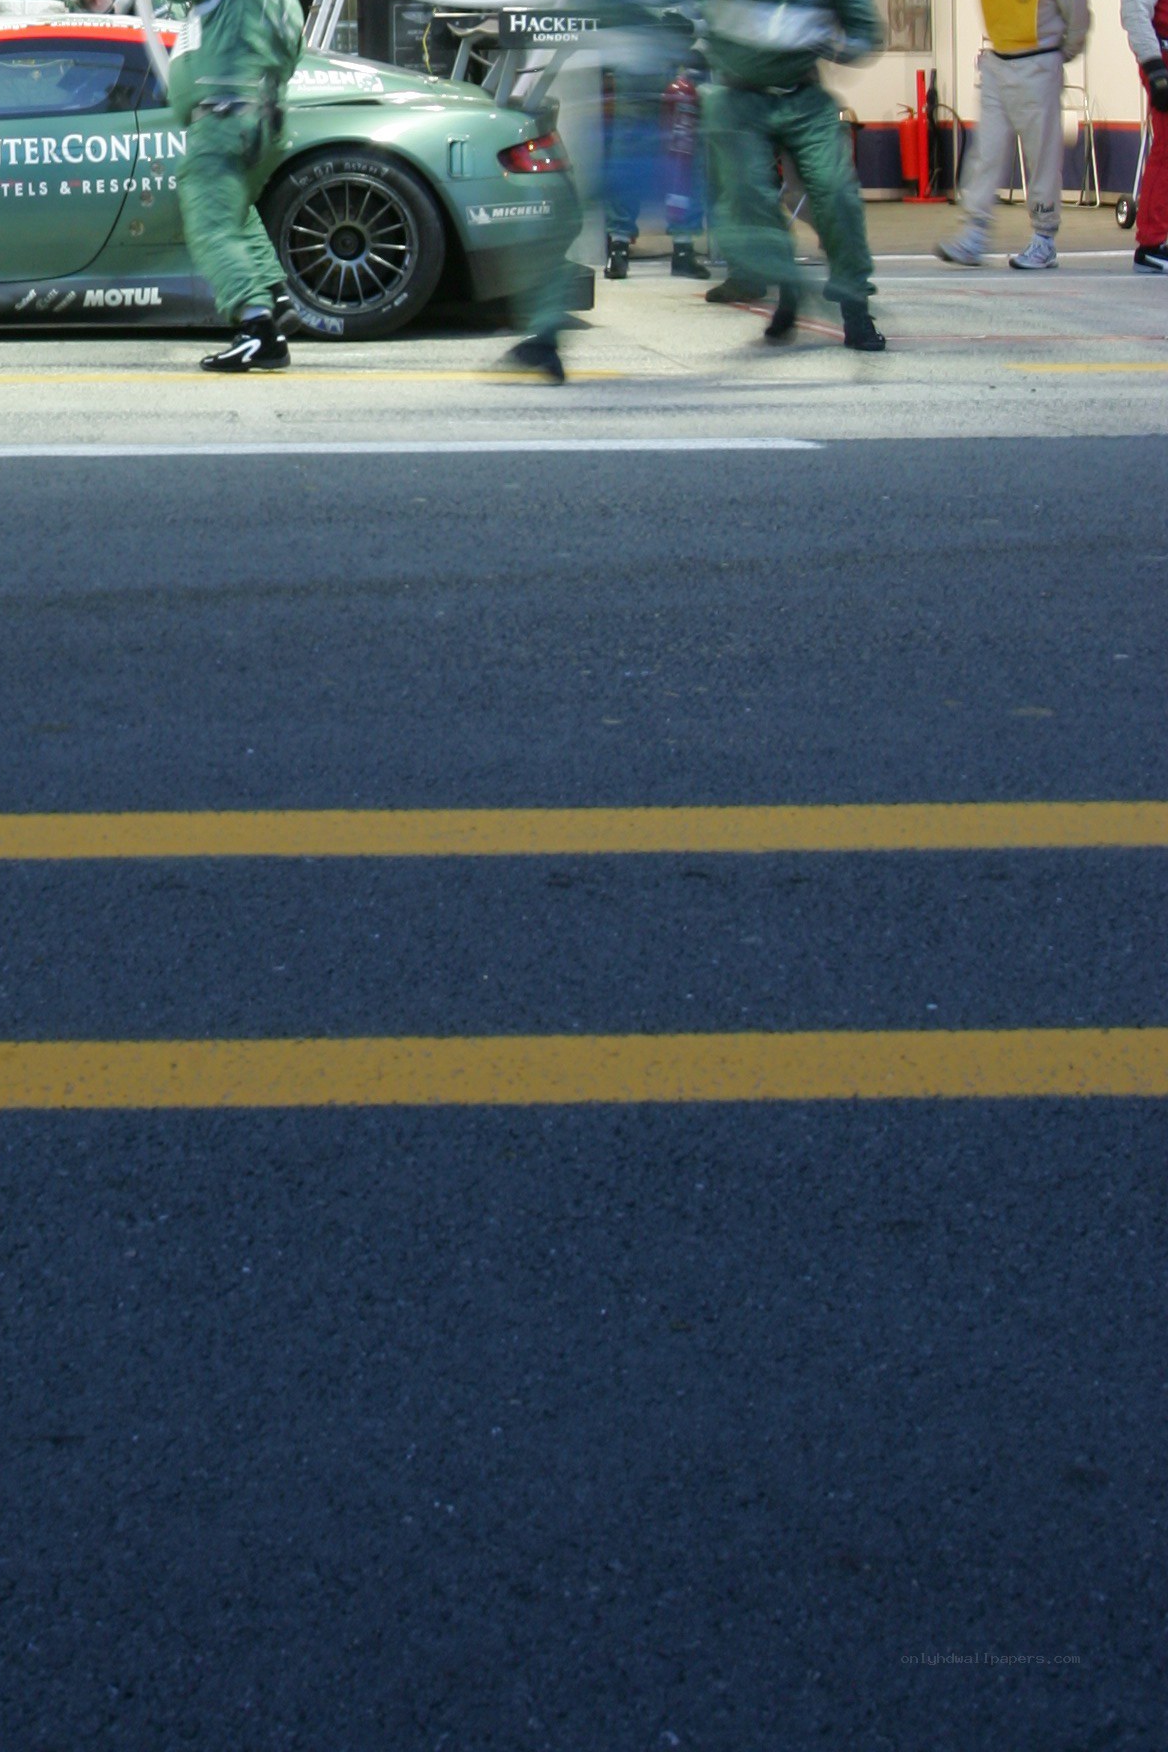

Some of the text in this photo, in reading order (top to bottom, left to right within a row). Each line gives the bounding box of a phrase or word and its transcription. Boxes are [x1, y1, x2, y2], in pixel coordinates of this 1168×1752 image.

[509, 13, 600, 33] HACKETT
[533, 33, 579, 43] LONDON
[60, 181, 72, 195] &
[82, 176, 177, 194] RESORTS
[492, 206, 551, 218] MICHELIN
[83, 287, 163, 308] MOTUL
